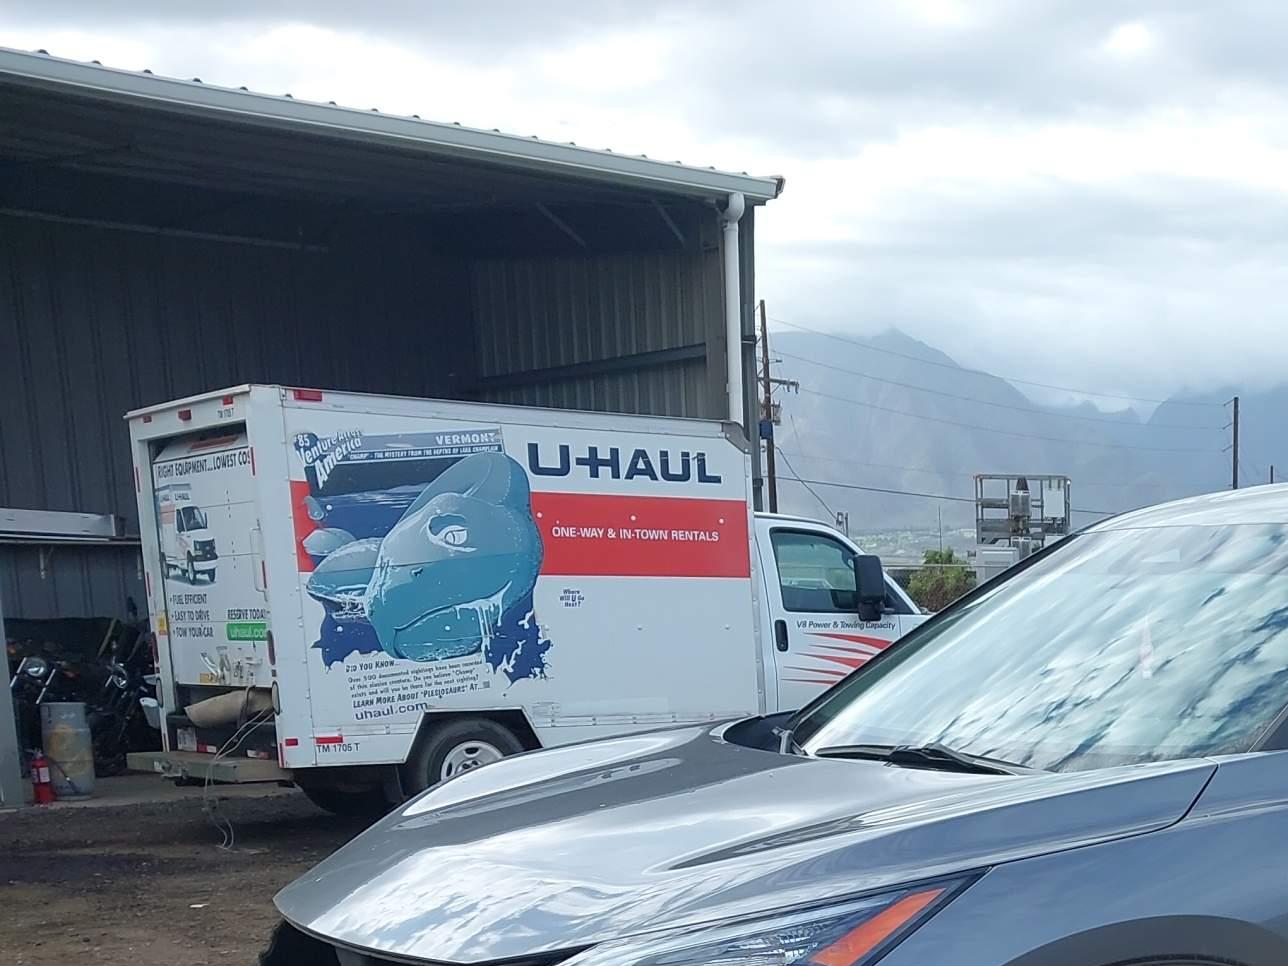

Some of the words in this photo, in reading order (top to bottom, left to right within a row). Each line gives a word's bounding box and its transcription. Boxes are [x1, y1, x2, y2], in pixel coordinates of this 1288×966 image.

[435, 432, 496, 445] VERMONT
[296, 437, 337, 465] Venture
[384, 450, 407, 459] MYSTERY
[238, 450, 251, 465] COS
[314, 437, 361, 490] America
[527, 442, 722, 484] U-HAUL
[552, 526, 604, 539] ONE-WAY
[607, 527, 616, 539] &
[619, 528, 669, 541] IN-TOWN
[671, 530, 719, 542] RENTALS
[173, 594, 184, 605] FUEL
[184, 593, 207, 604] EFFICIENT
[571, 594, 577, 602] U
[174, 610, 187, 621] EASY
[187, 610, 194, 620] TO
[194, 610, 210, 620] DRIVE
[227, 609, 249, 620] RESERVE
[176, 626, 188, 637] TOW
[189, 626, 203, 637] YOUR
[203, 626, 214, 637] CAR
[797, 621, 807, 629] V8
[808, 621, 831, 629] Power
[832, 621, 839, 629] &
[840, 621, 865, 630] Towing
[865, 621, 896, 630] Capacity
[359, 662, 373, 671] YOU
[353, 698, 374, 709] LEARN
[376, 695, 395, 705] MORE
[397, 691, 419, 702] ABOUT
[355, 702, 428, 721] uhaul.com
[316, 744, 331, 753] TM
[354, 742, 360, 751] T
